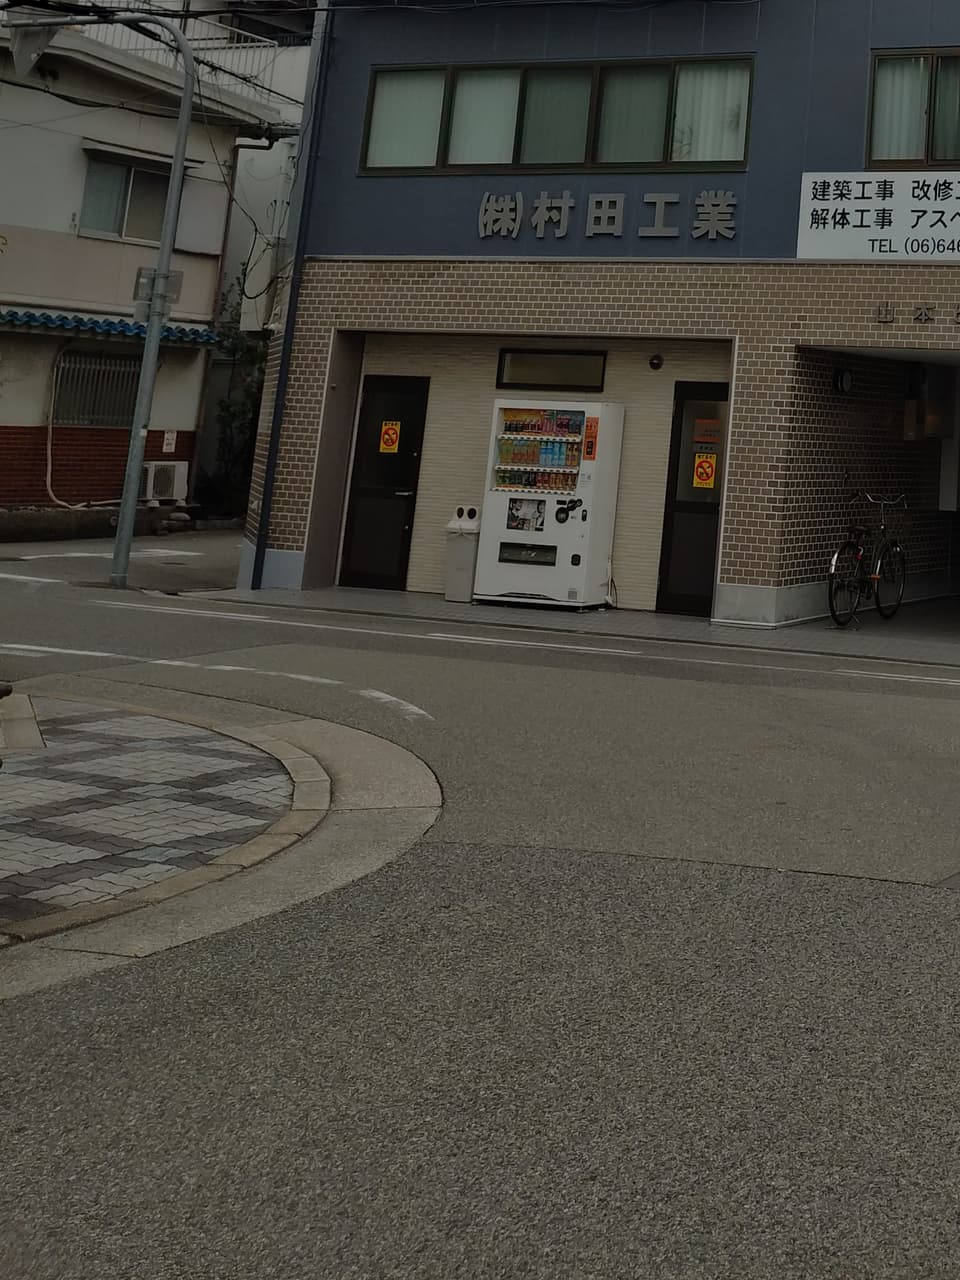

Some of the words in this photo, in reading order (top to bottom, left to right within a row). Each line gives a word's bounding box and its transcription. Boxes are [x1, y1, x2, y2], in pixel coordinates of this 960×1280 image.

[811, 180, 895, 201] 建築工事
[810, 208, 894, 230] 解体工事
[868, 238, 899, 254] TEL
